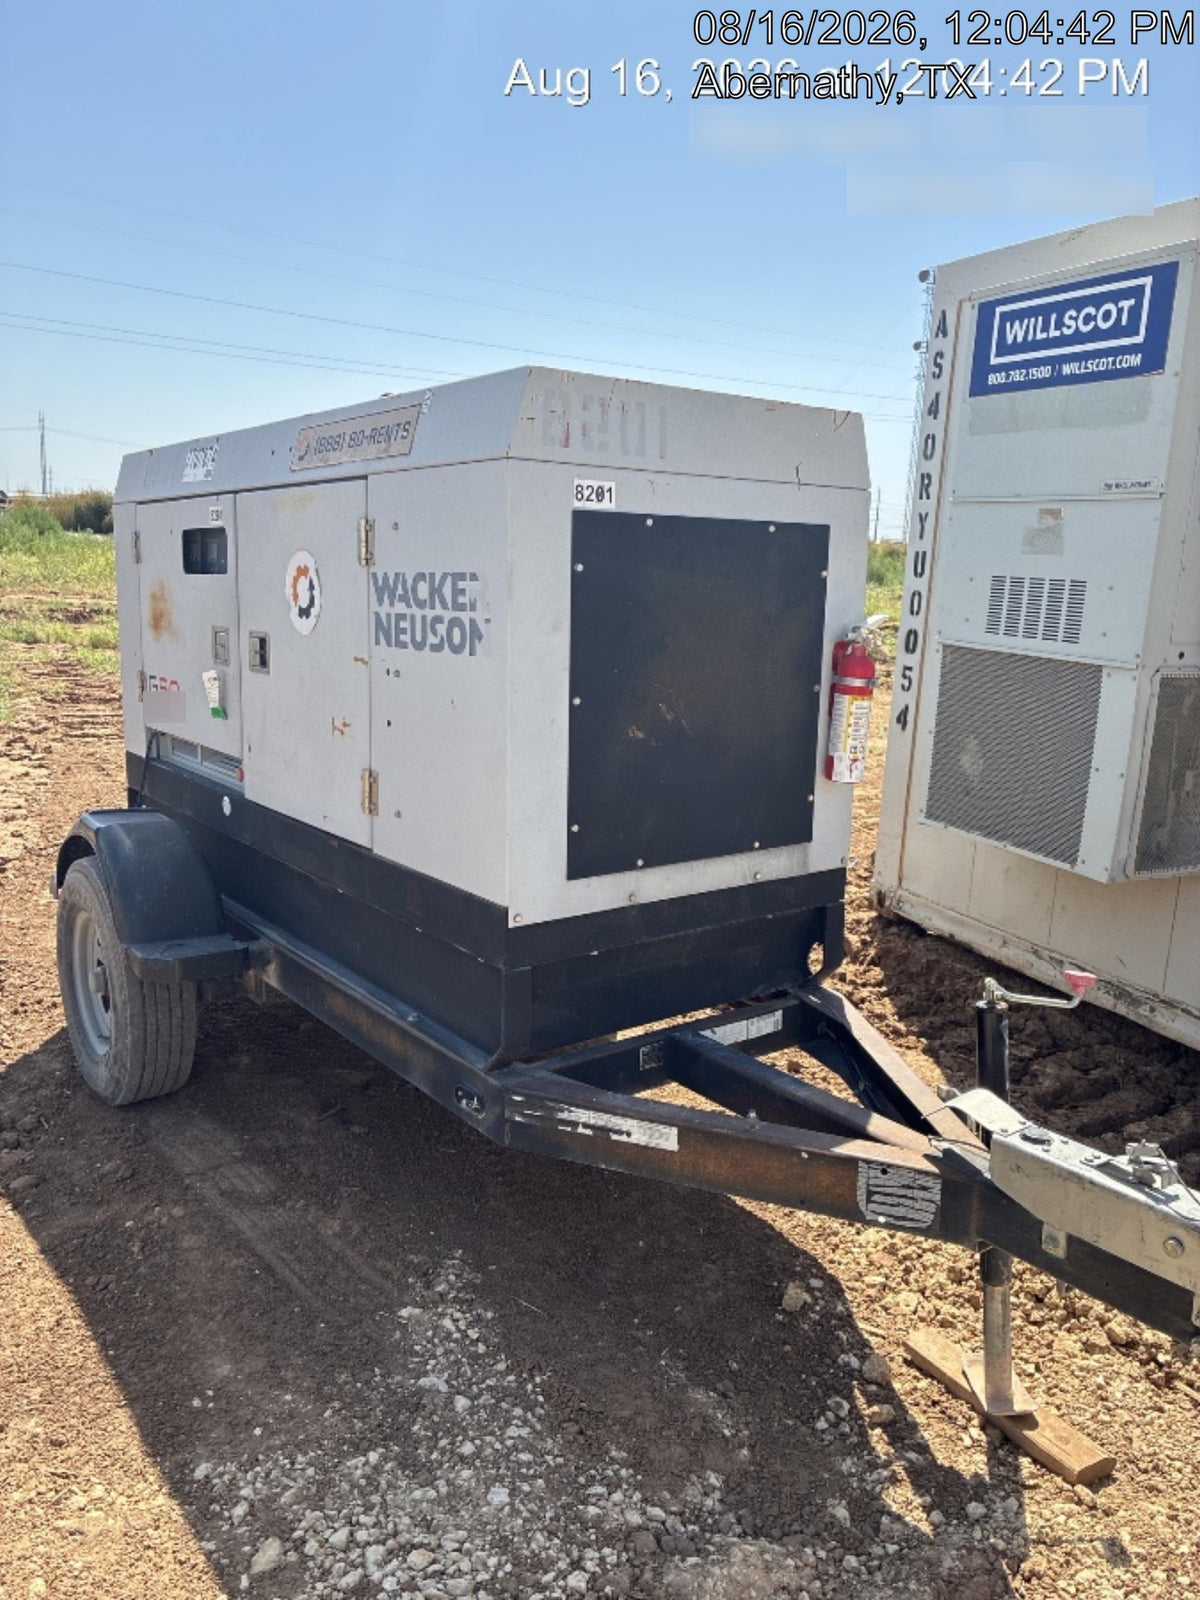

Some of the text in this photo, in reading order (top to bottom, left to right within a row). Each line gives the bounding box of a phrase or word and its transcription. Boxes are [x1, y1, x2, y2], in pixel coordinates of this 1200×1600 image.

[1005, 299, 1136, 345] WILLSCOT
[1062, 353, 1143, 376] WILLSCOT.COM
[575, 484, 613, 504] 8201
